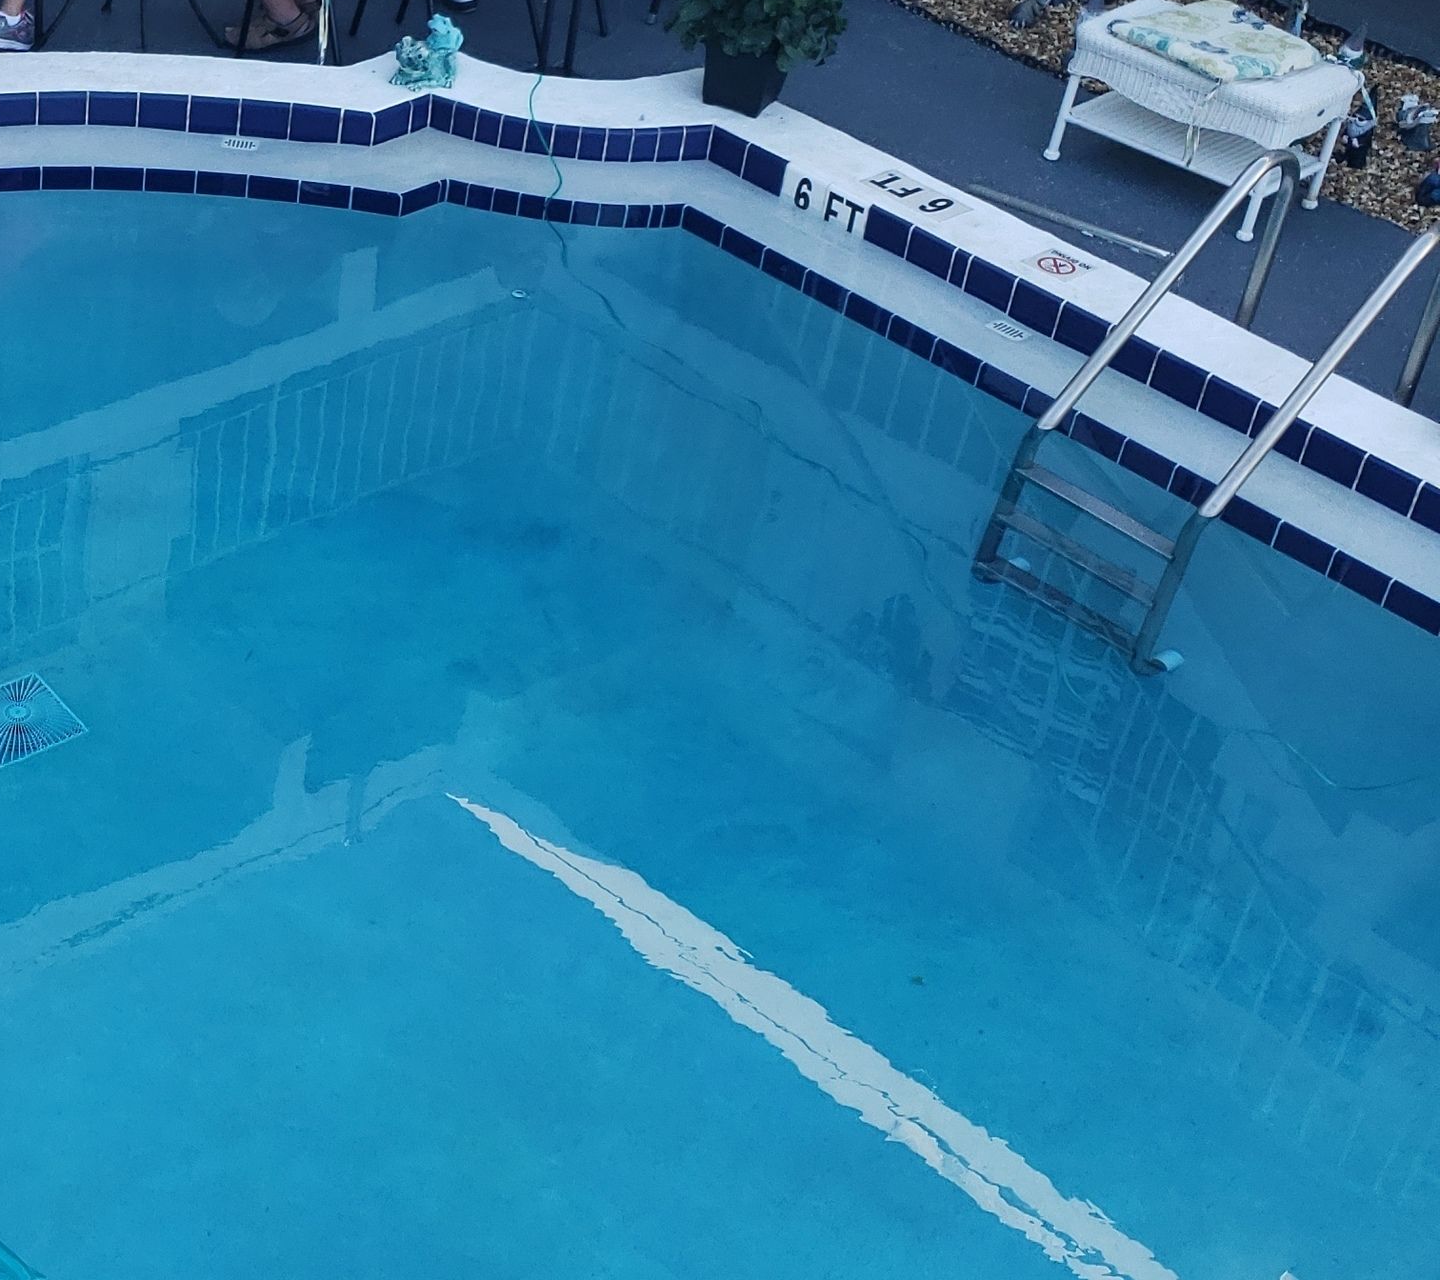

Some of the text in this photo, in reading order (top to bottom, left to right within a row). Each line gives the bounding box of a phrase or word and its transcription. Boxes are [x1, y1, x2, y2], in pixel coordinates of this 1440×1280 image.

[793, 177, 864, 234] 6 FT
[869, 172, 954, 213] 6 FT
